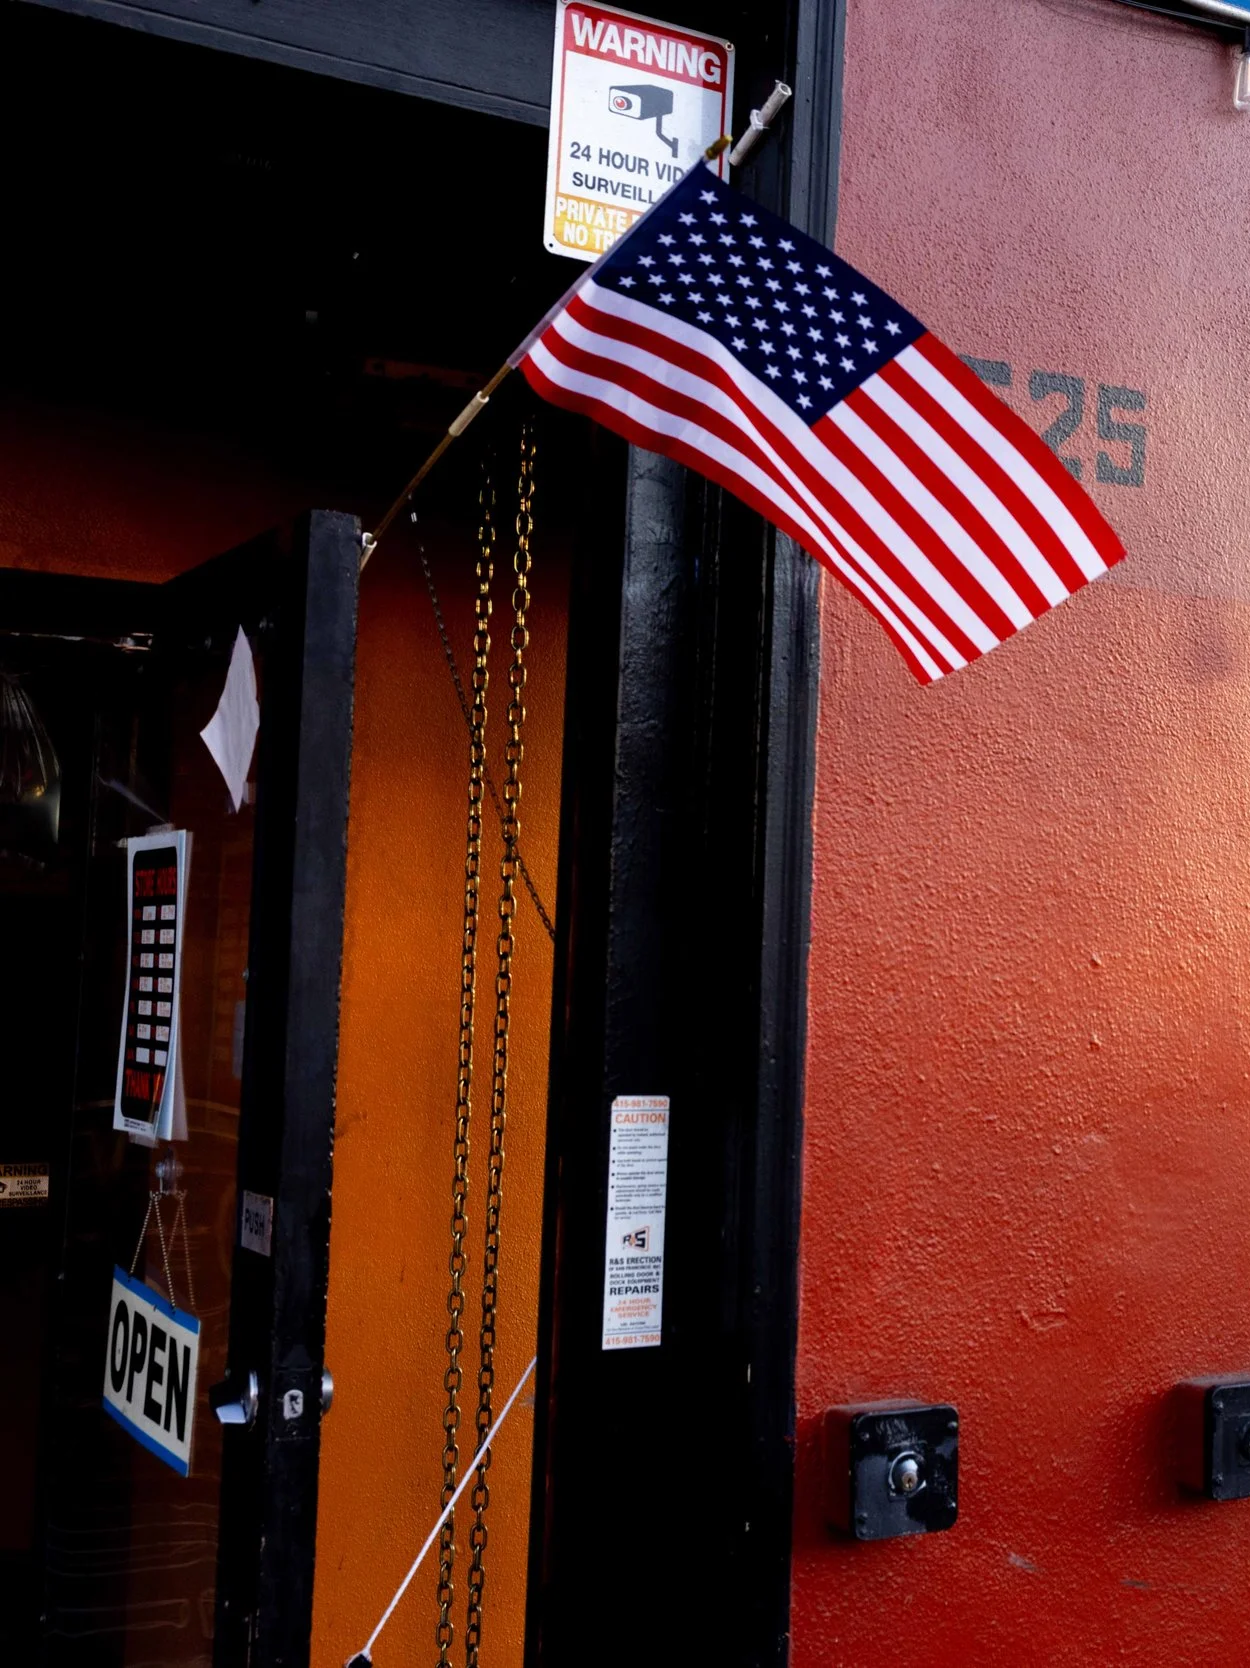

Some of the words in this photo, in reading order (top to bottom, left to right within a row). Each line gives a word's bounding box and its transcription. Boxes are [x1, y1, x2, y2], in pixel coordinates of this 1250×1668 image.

[571, 13, 721, 84] WARNING
[570, 141, 592, 162] 24
[599, 148, 650, 177] HOUR
[655, 161, 688, 184] VID
[572, 171, 661, 204] SURVEILL
[556, 196, 627, 232] PRIVATE
[563, 222, 588, 246] NO
[592, 228, 619, 251] TR
[957, 353, 1147, 488] 25
[615, 1112, 666, 1124] CAUTION
[0, 1166, 47, 1176] RNING
[244, 1208, 265, 1237] PUSH
[609, 1257, 624, 1265] R&S
[626, 1255, 662, 1264] ERECTION
[609, 1285, 660, 1296] REPAIRS
[110, 1300, 191, 1443] OPEN
